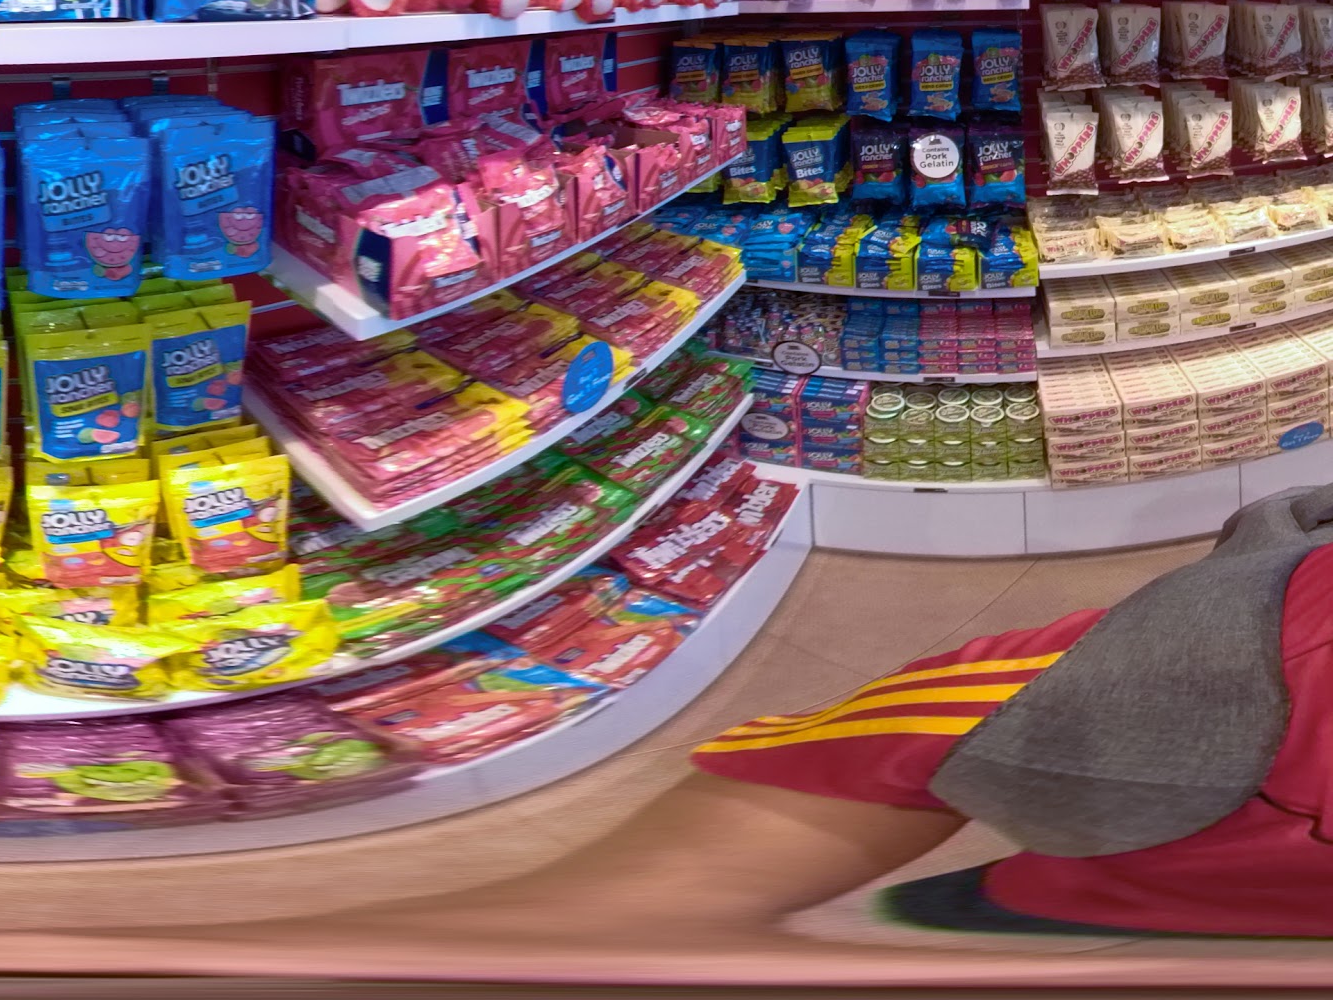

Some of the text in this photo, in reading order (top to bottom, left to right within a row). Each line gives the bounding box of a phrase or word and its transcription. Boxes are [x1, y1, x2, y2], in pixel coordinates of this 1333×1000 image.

[1058, 19, 1094, 70] WHOPPERS
[1118, 19, 1157, 68] WHOPPERS
[1188, 15, 1226, 60] WHOPPERS
[788, 47, 820, 64] JOLLY
[980, 56, 1011, 71] JOLLY
[852, 64, 883, 78] JOLLY
[920, 64, 951, 77] JOLLY
[921, 73, 953, 83] rancher
[1268, 98, 1298, 145] WHOPPERS
[1123, 113, 1160, 164] WHOPPERS
[1195, 113, 1229, 163] WHOPPERS
[791, 147, 820, 162] JOLLY
[860, 143, 891, 156] JOLLY
[861, 152, 893, 162] rancher
[925, 152, 948, 160] Pork
[1054, 124, 1095, 175] WHOPPERS
[174, 156, 230, 188] JOLLY
[729, 166, 757, 177] Bites
[795, 165, 825, 179] Bites
[919, 160, 955, 169] Gelatin
[38, 172, 101, 203] JOLLY
[161, 338, 215, 368] JOLLY
[785, 355, 808, 363] Pork
[779, 361, 815, 369] Gelatin
[45, 365, 108, 394] JOLLY
[1130, 396, 1194, 417] WHOPPERS
[1051, 407, 1118, 424] WHOPPERS
[1055, 434, 1121, 451] WHOPPERS
[1058, 460, 1124, 477] WHOPPERS
[184, 487, 246, 515] JOLLY
[42, 509, 108, 529] JOLLY
